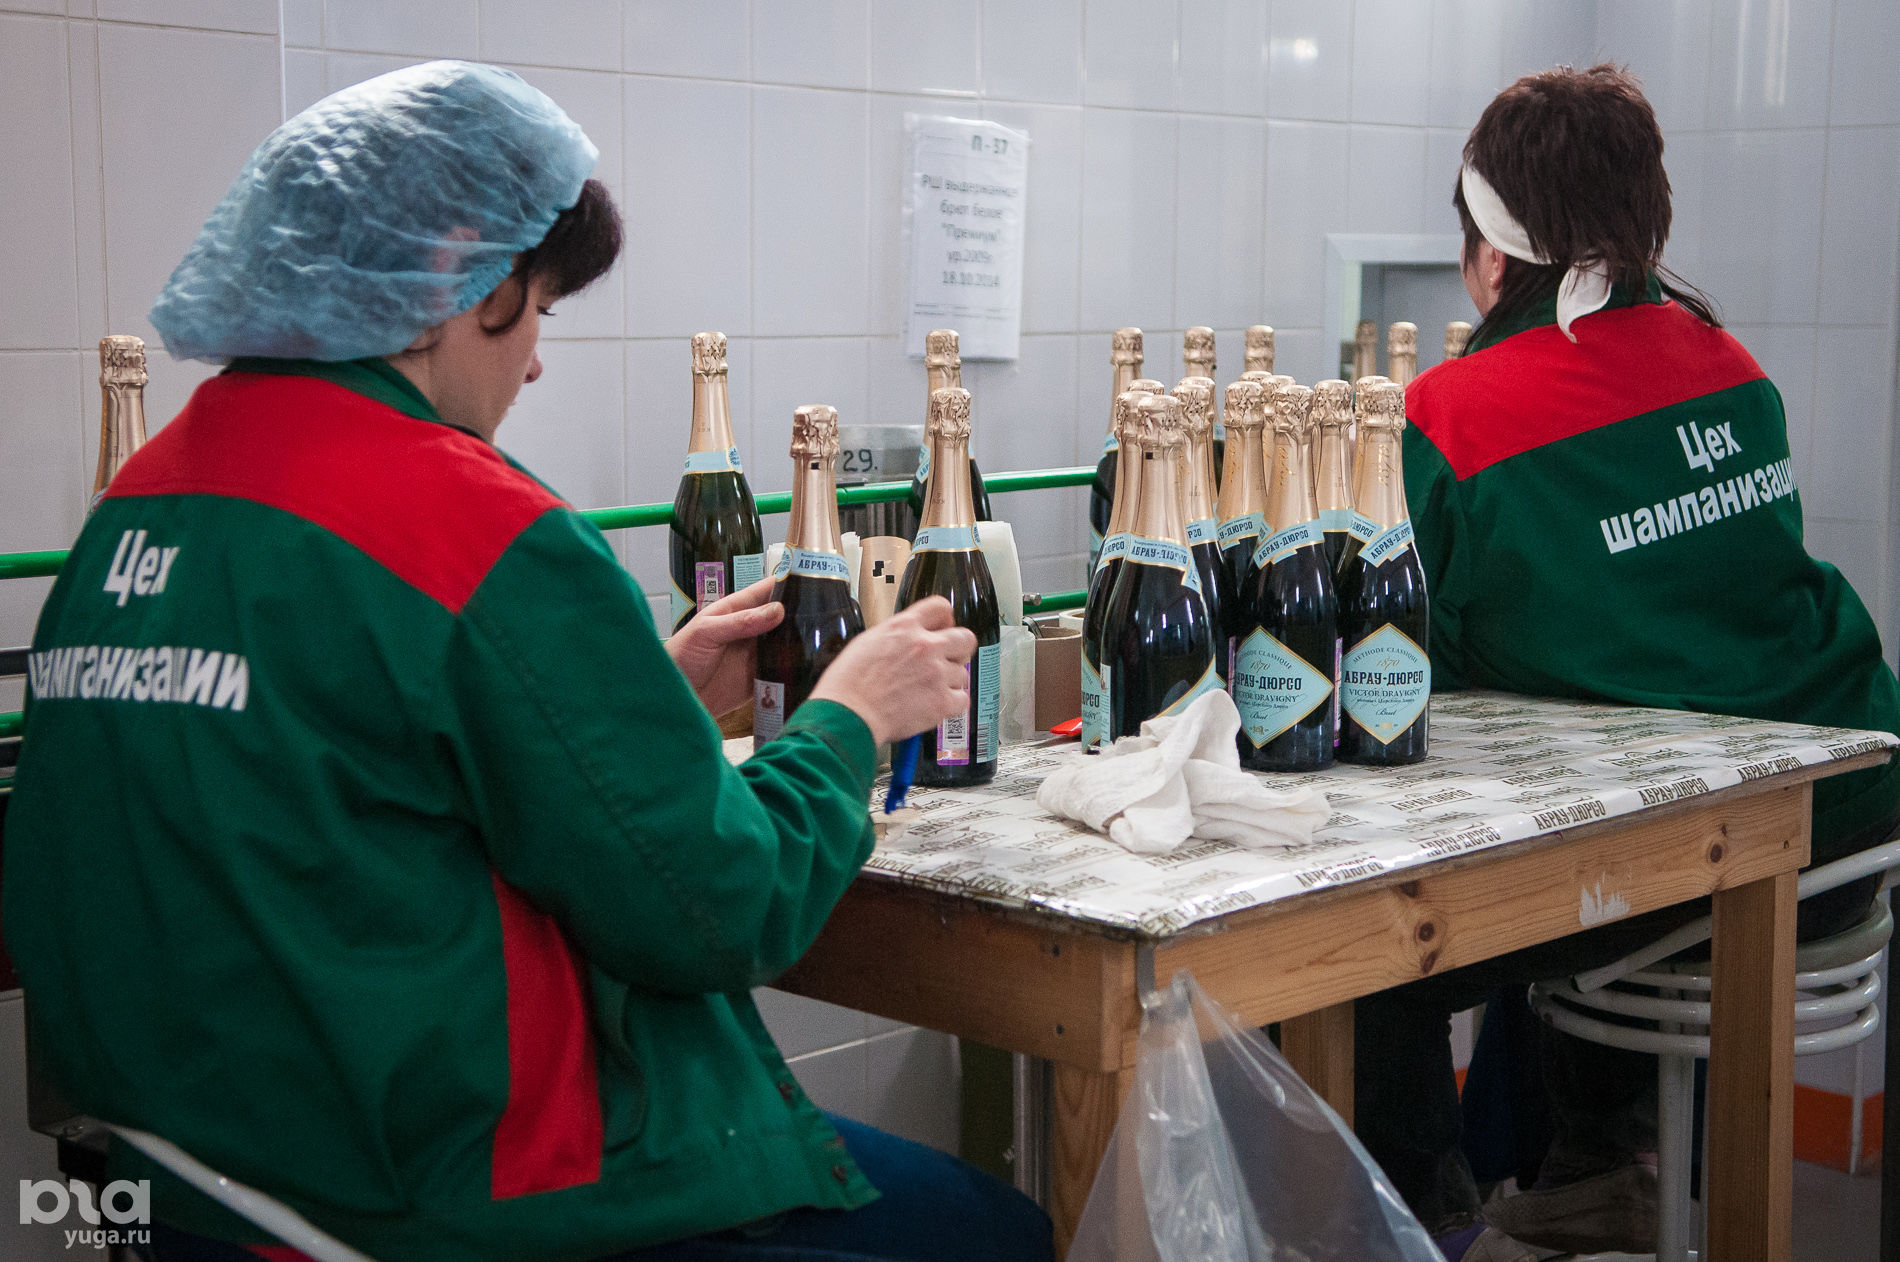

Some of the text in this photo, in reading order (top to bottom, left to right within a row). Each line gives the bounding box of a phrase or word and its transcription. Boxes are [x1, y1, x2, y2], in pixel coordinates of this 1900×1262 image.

[1677, 421, 1743, 473] Цех
[1599, 456, 1797, 555] шампанизаци
[1258, 529, 1309, 562] АБРАУ-ДЮРСО
[103, 529, 180, 608] Цех
[1344, 670, 1424, 687] АБРАУ-ДЮРСО
[1349, 688, 1421, 698] VICTOR DRAVIGNY
[1255, 693, 1297, 703] DRAVIGNY
[1638, 778, 1710, 806] АБРАУ-ДЮРСО
[1532, 800, 1607, 830] АБРАУ-ДЮРСО
